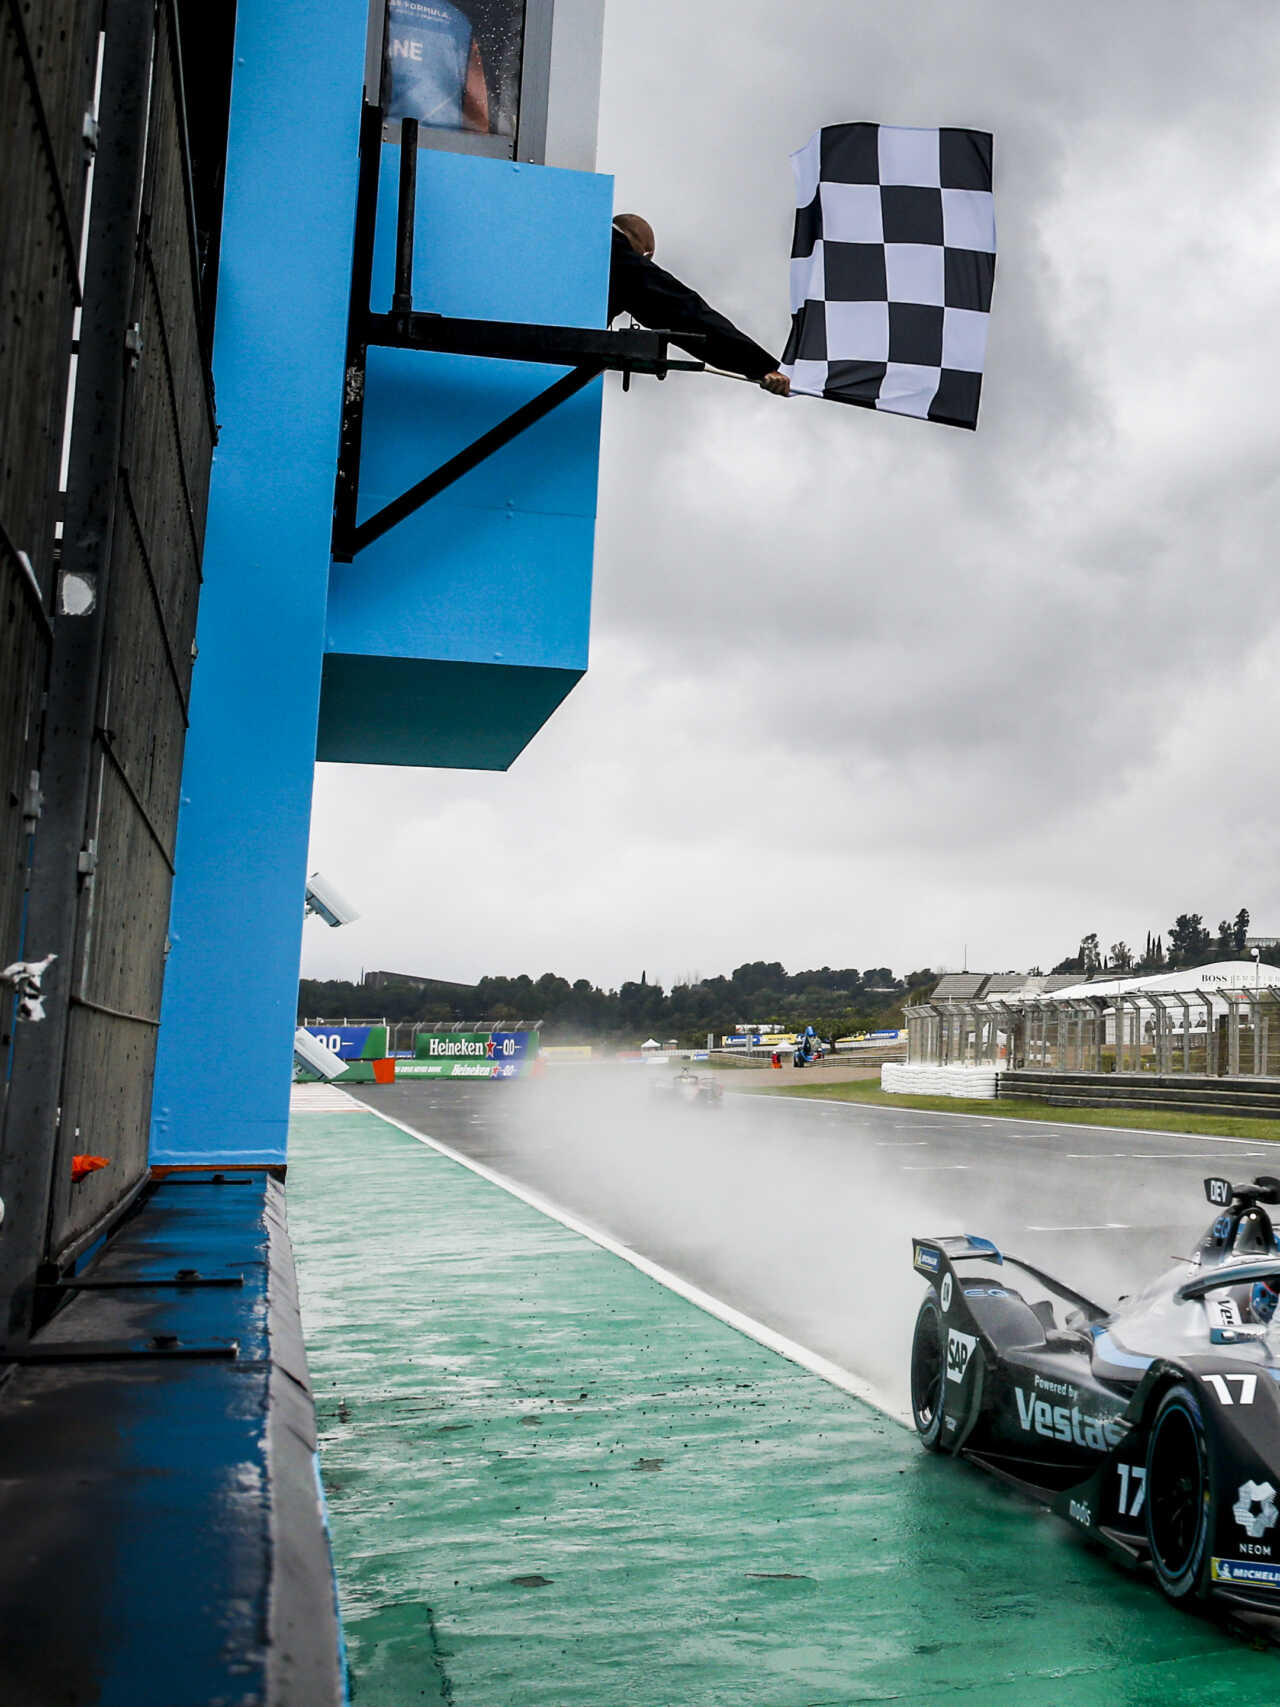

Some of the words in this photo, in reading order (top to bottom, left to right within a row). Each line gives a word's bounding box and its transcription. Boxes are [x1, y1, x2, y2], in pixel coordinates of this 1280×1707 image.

[1201, 974, 1228, 983] BOSS
[429, 1038, 484, 1056] Heineken
[1210, 1180, 1228, 1203] DEV
[948, 1338, 968, 1374] SAP
[1034, 1374, 1067, 1394] Powered
[1068, 1384, 1079, 1401] by
[1200, 1374, 1257, 1405] 17
[1117, 1463, 1147, 1517] 17
[1239, 1543, 1272, 1556] NEOM
